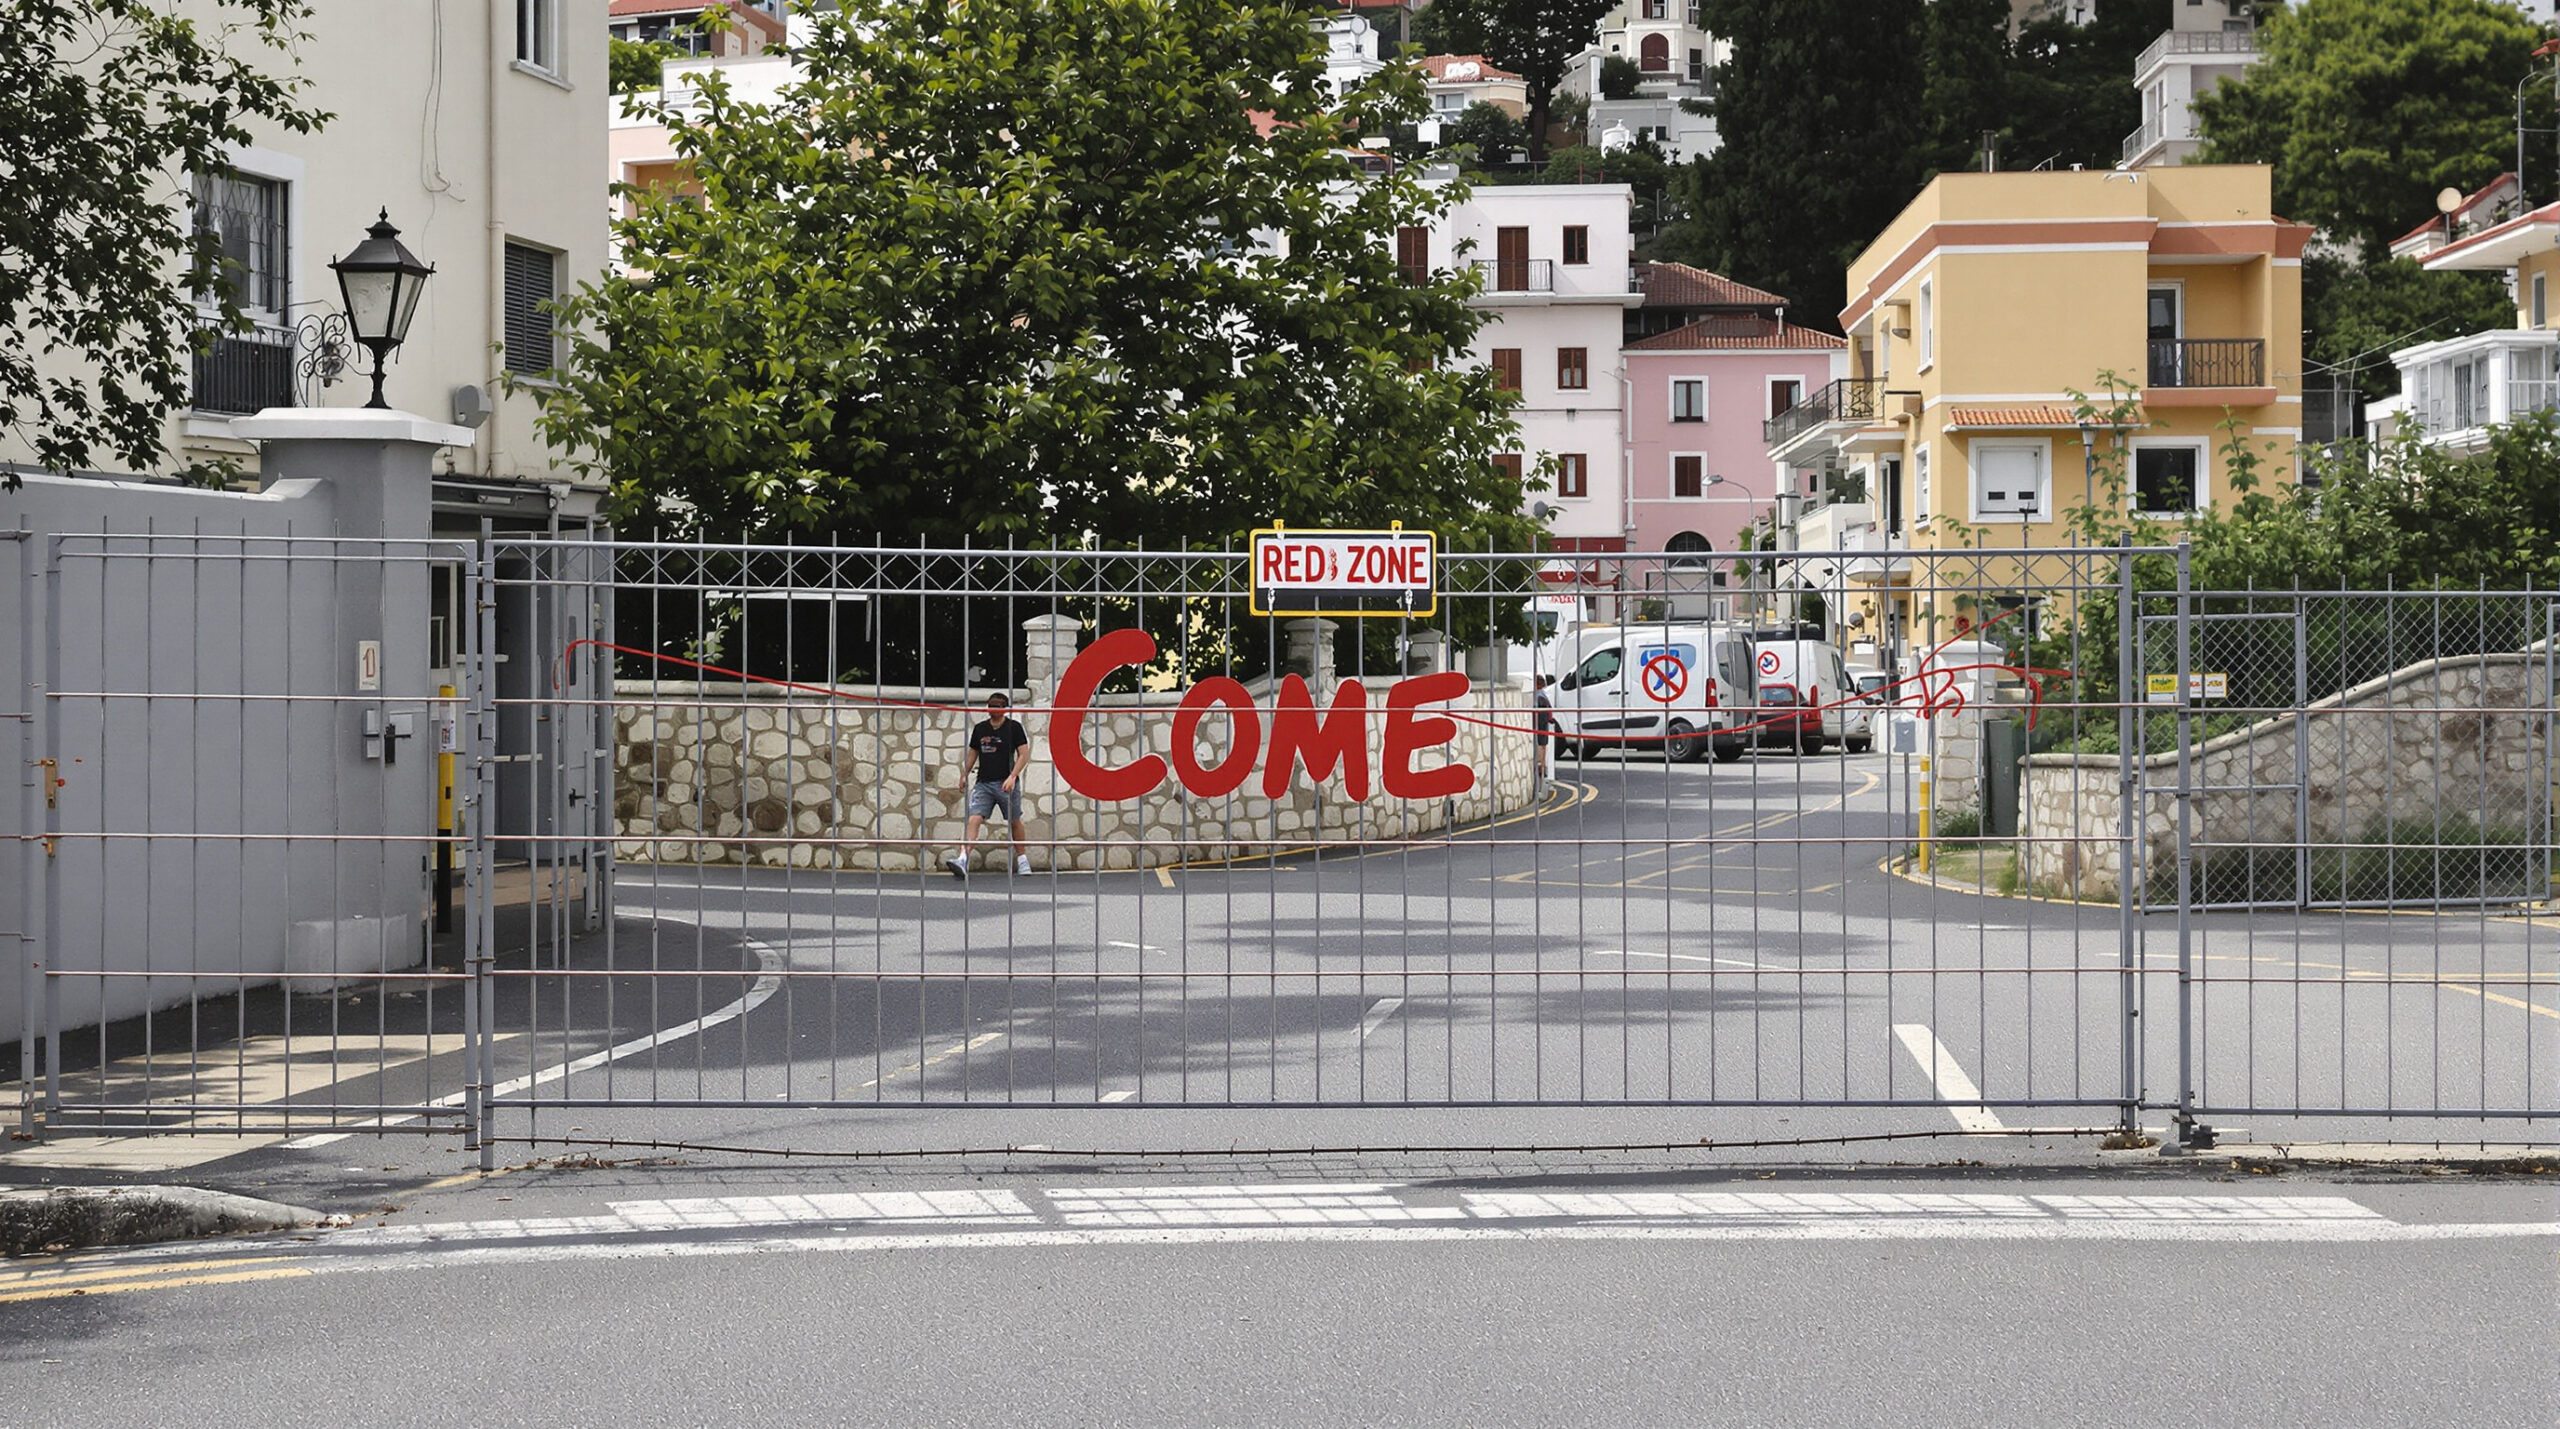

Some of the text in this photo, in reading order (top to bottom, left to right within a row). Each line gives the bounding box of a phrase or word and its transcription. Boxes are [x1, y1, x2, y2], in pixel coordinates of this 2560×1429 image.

[1263, 545, 1428, 584] RED ZONE
[1049, 628, 1476, 802] COME
